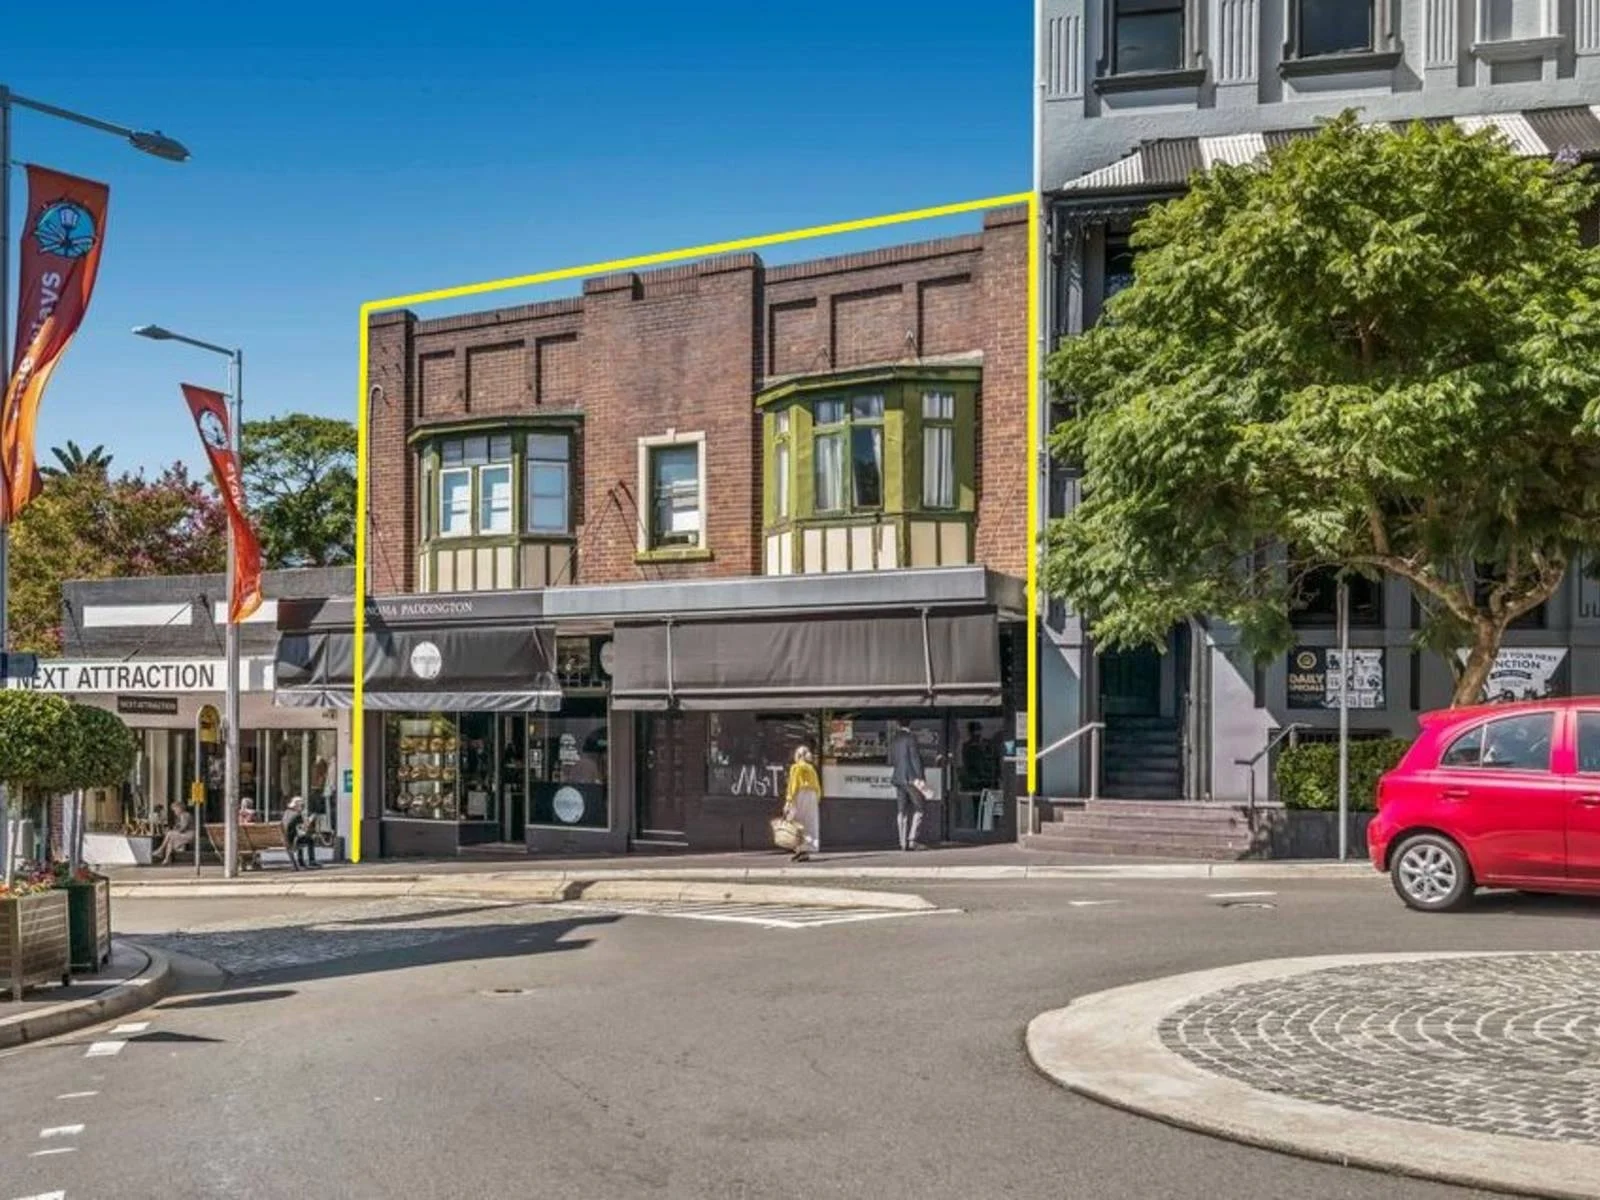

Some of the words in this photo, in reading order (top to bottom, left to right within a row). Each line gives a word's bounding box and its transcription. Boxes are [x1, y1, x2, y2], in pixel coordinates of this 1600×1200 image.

[400, 602, 472, 616] PADDINGTON
[1495, 660, 1541, 669] NCTION
[77, 664, 215, 688] ATTRACTION
[1288, 673, 1325, 684] DAILY
